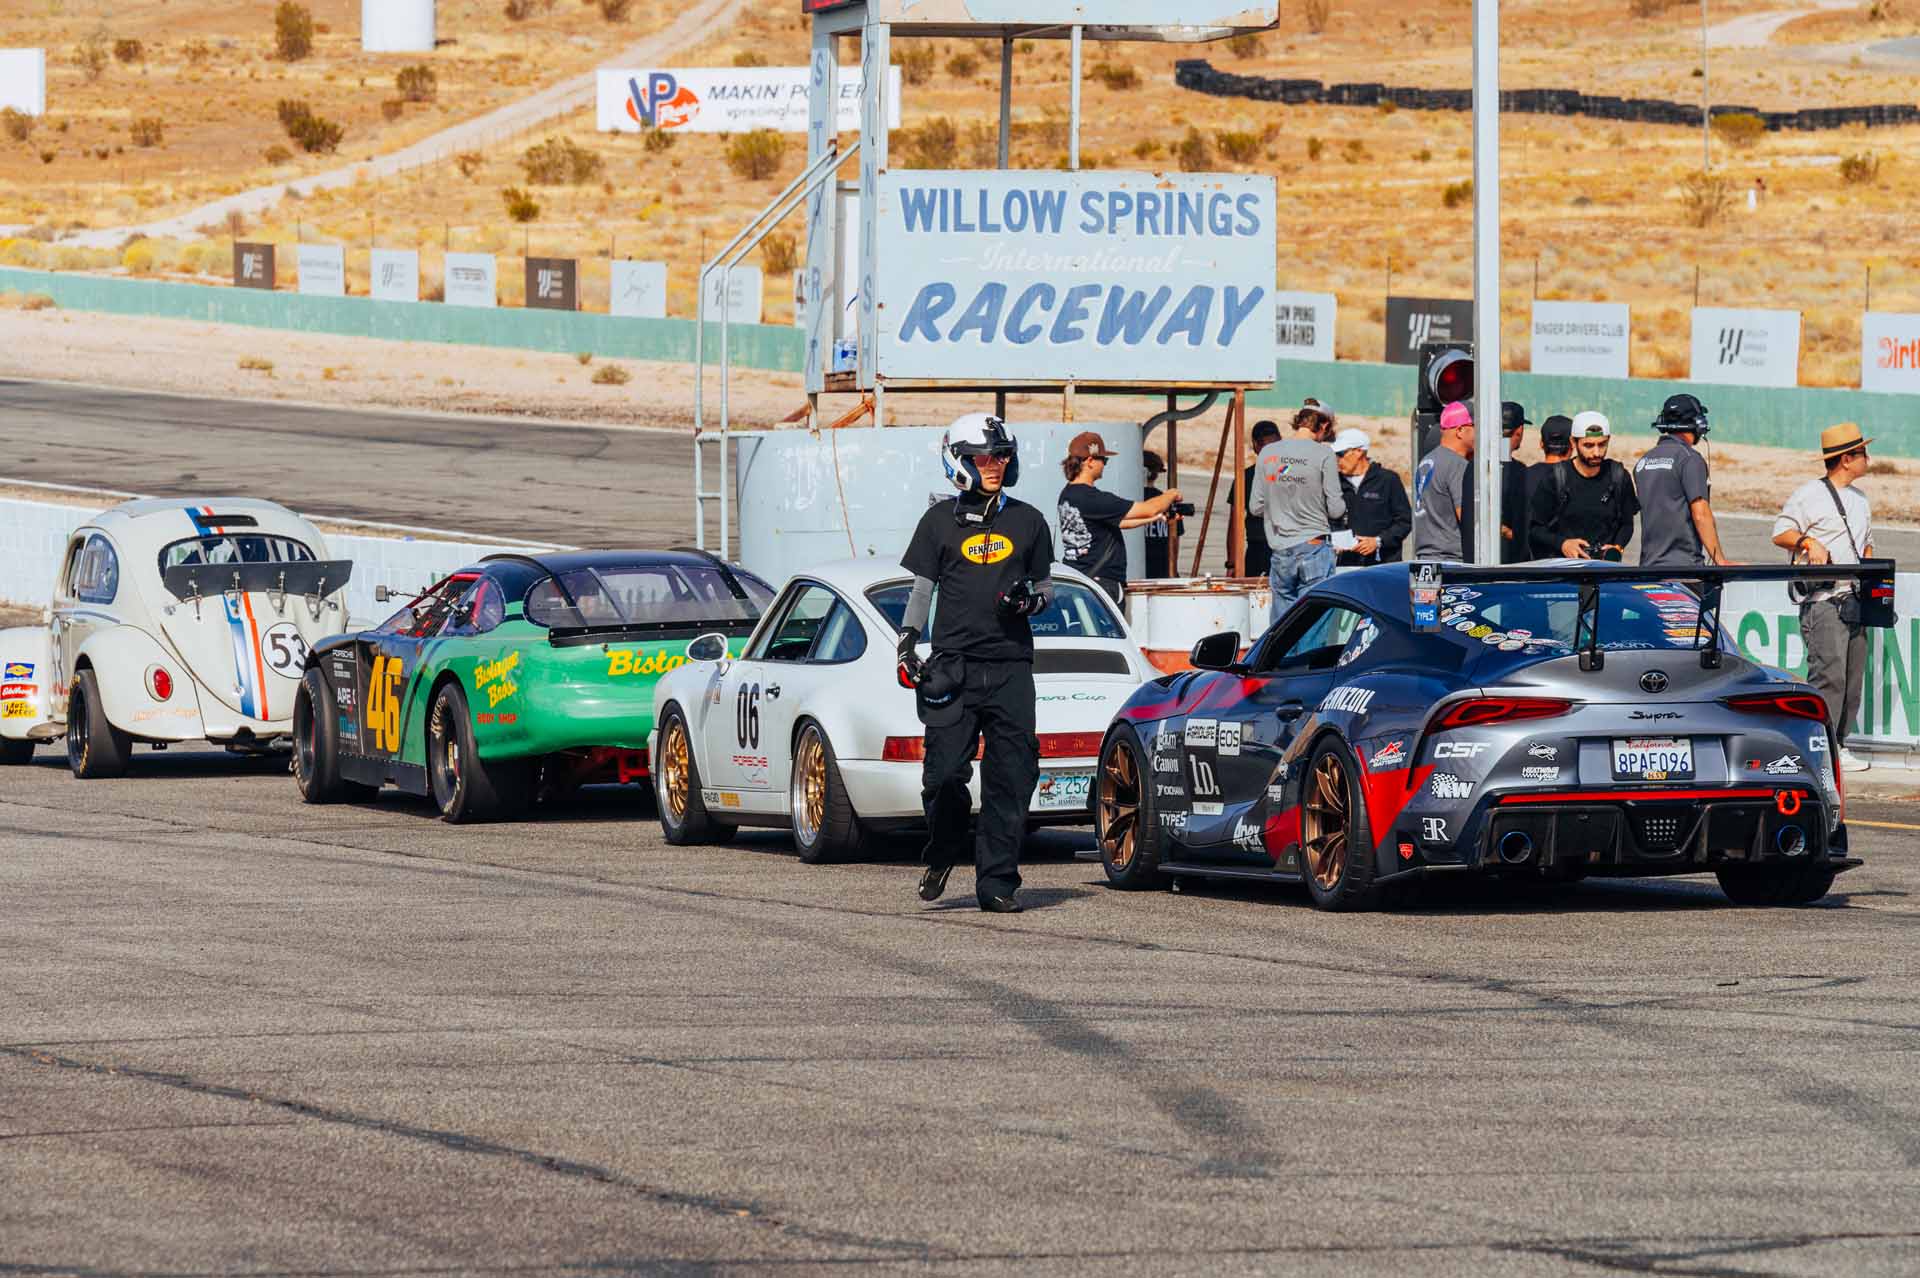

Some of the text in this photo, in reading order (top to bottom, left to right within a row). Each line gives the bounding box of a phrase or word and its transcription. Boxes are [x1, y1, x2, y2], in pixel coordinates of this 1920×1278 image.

[629, 73, 677, 127] VP
[790, 84, 865, 100] POER
[899, 188, 1261, 237] WILLOW SPRINGS
[978, 243, 1184, 273] International
[898, 281, 1265, 347] RACEWAY
[1280, 455, 1308, 466] ICONIC
[270, 633, 308, 669] 53
[1737, 610, 1920, 736] SPIN
[366, 655, 404, 753] 46
[737, 682, 760, 750] 06
[1627, 711, 1685, 724] Supra
[1219, 730, 1240, 747] EOS
[1434, 742, 1491, 758] CSF
[1153, 754, 1179, 773] Canon
[1619, 752, 1689, 776] 8PAF096
[1437, 781, 1475, 799] KW
